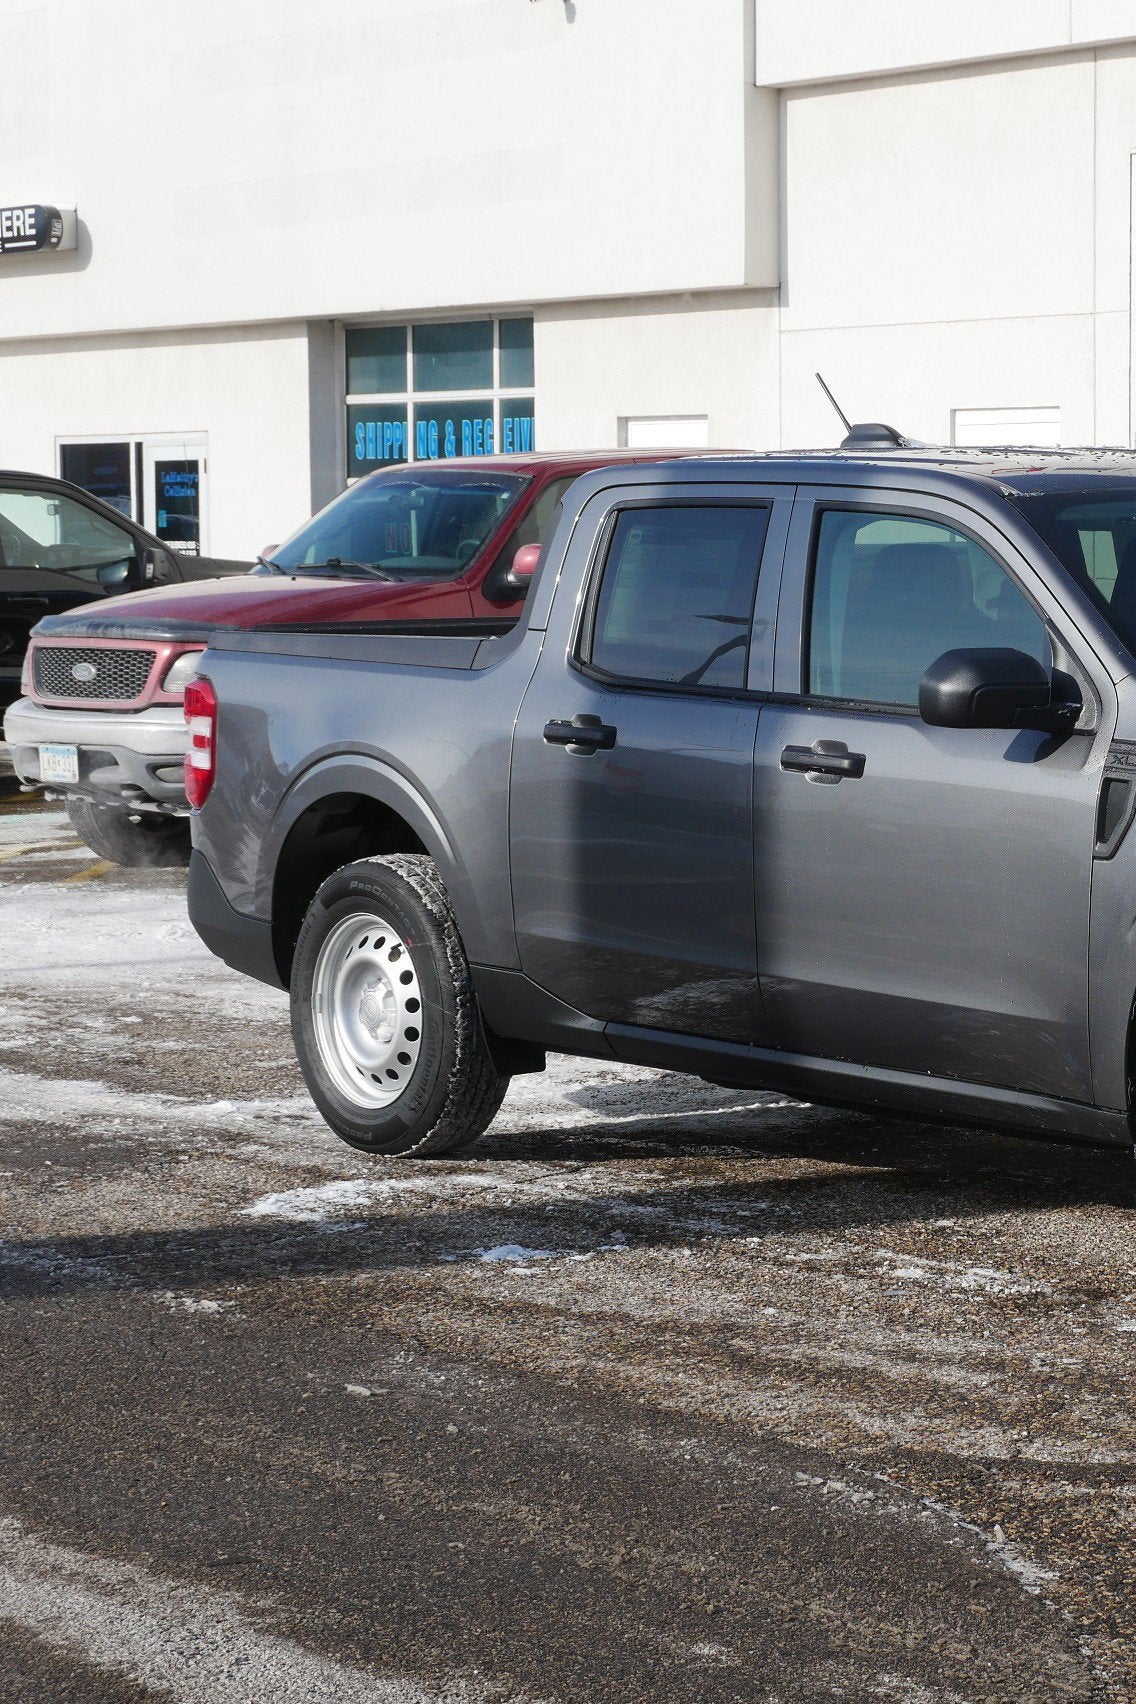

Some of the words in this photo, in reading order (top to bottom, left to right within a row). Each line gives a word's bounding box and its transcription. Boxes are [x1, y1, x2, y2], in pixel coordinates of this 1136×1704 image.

[0, 207, 37, 238] ERE
[355, 420, 439, 460] SHIPPING
[444, 419, 456, 459] &
[1110, 755, 1136, 767] XL
